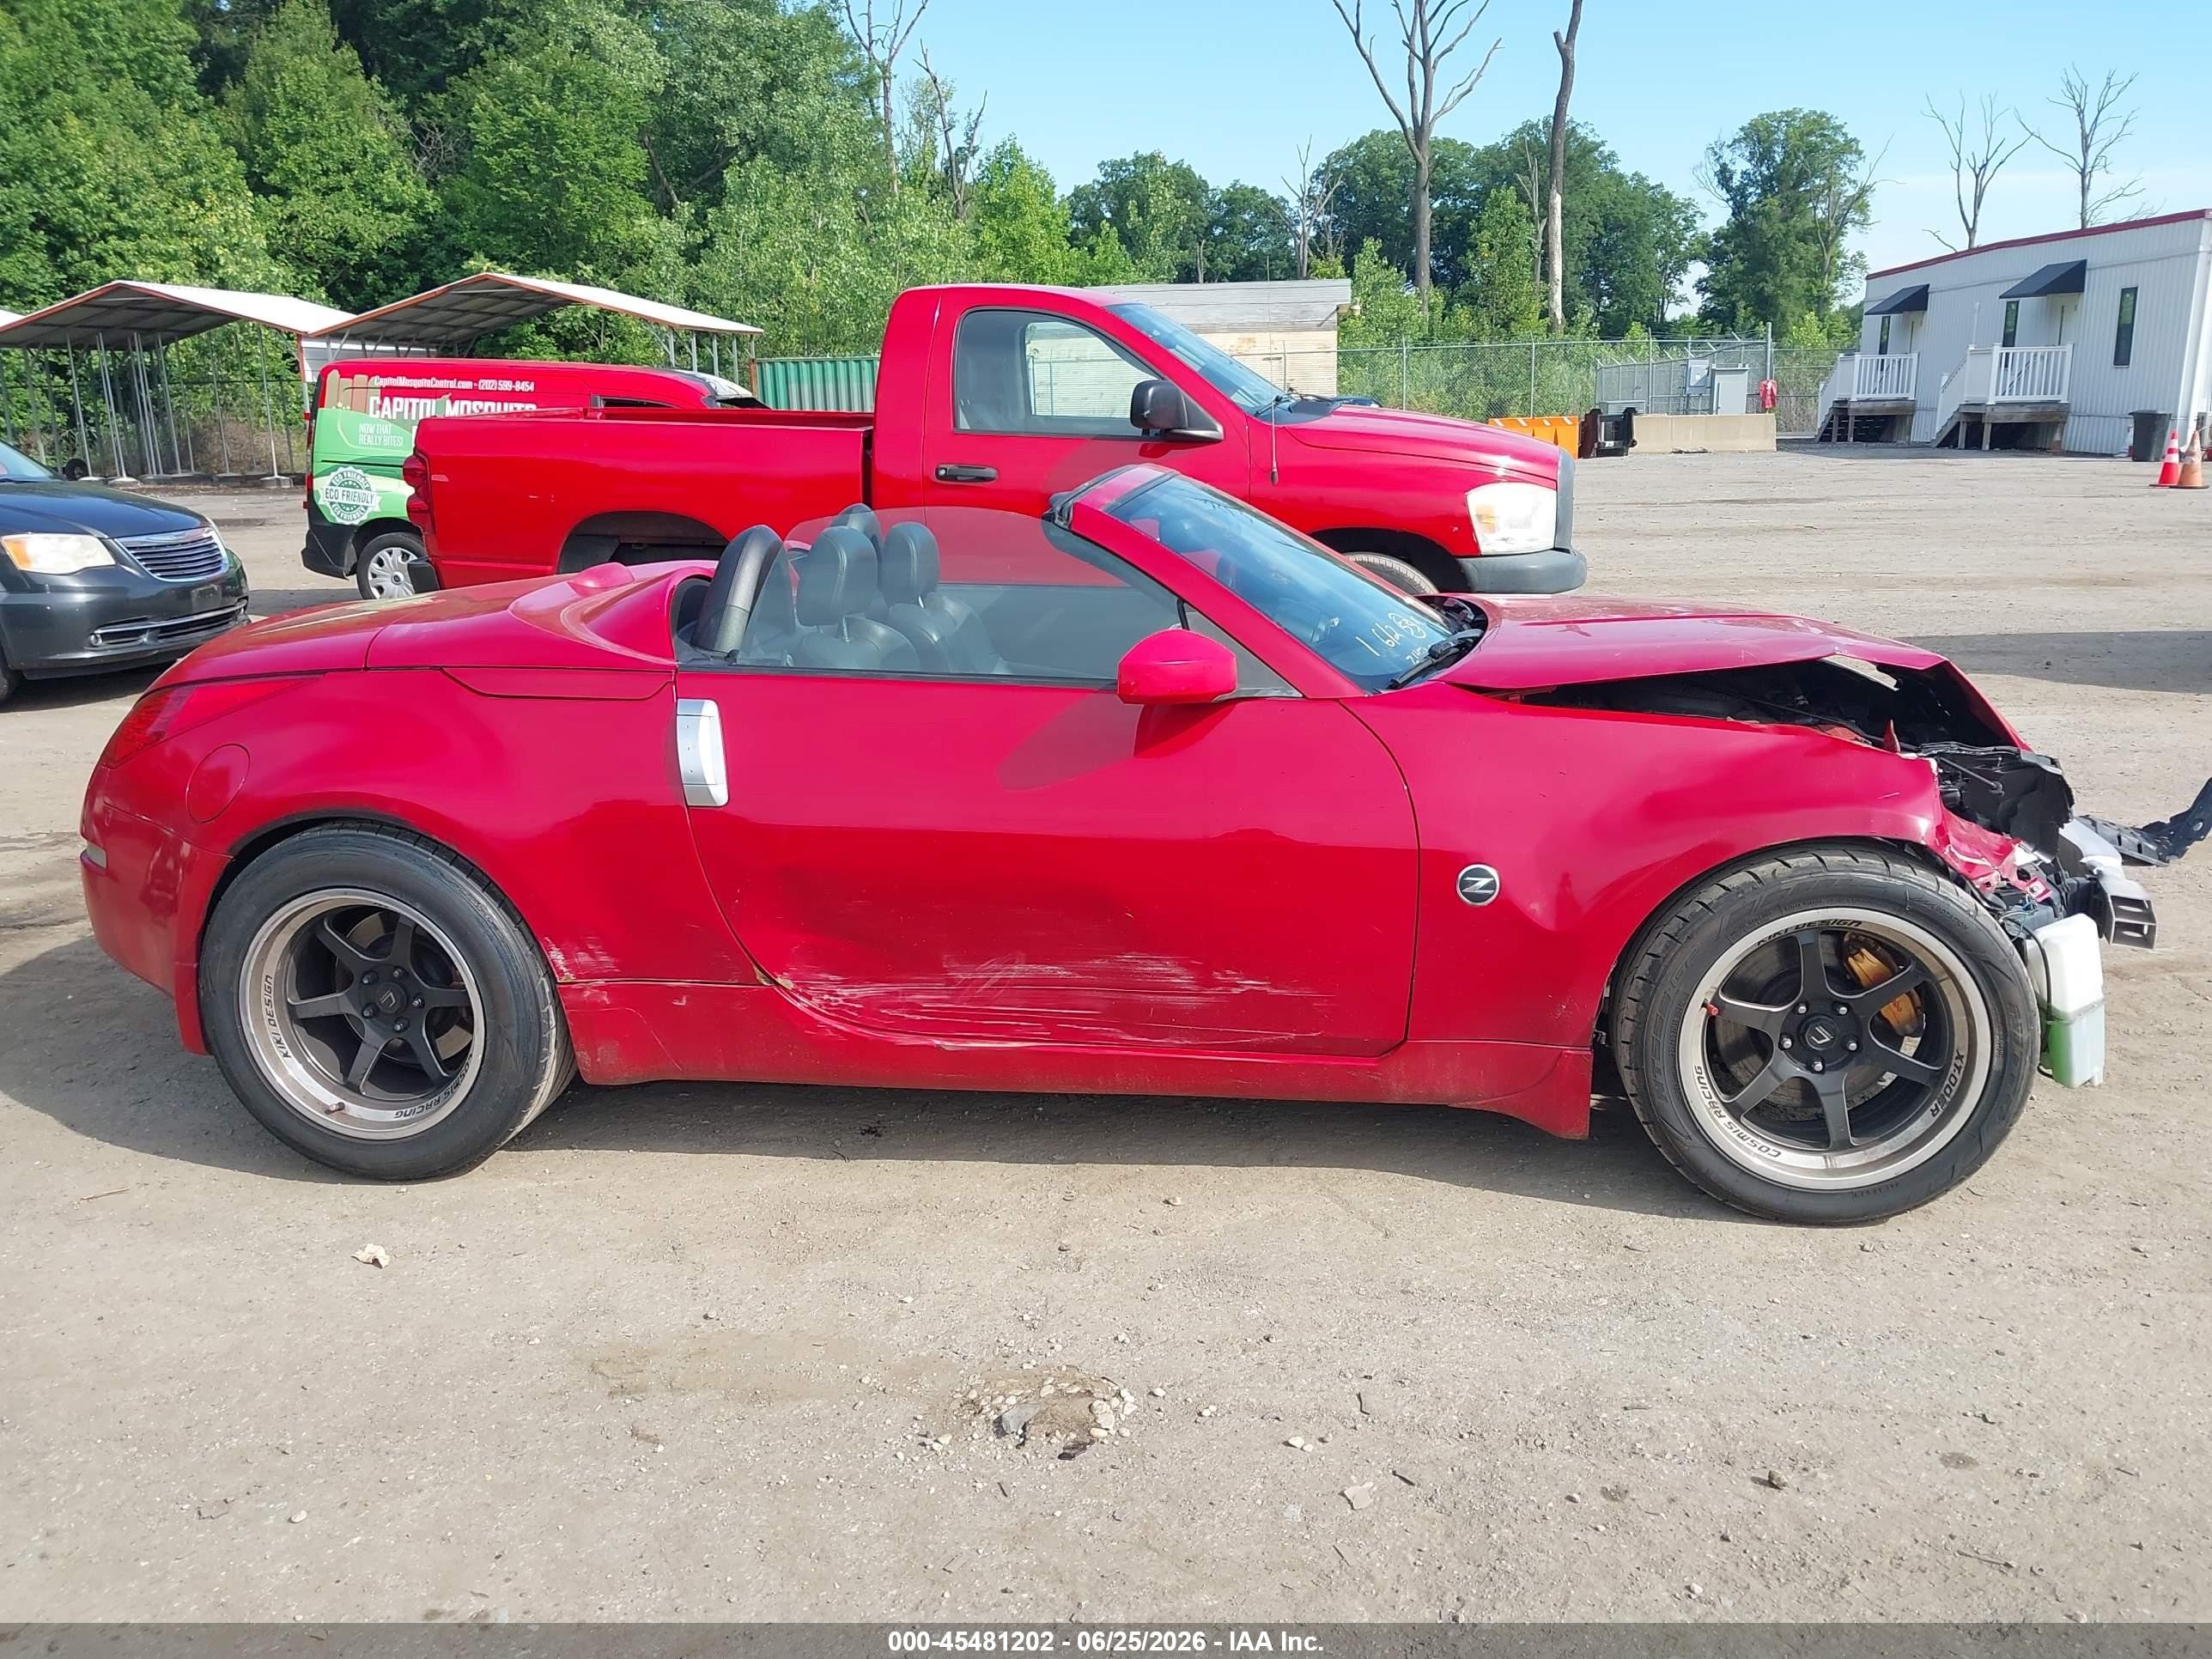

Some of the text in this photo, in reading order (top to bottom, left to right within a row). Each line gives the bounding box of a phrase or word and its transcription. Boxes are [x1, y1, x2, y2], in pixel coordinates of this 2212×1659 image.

[374, 375, 473, 390] CapitolMosquitoControl.com
[478, 379, 497, 391] (202)
[498, 380, 535, 392] 599-8454
[368, 395, 538, 421] CAPITOL MOSQ
[358, 422, 392, 435] NOW THAT
[358, 433, 383, 446] REALLY
[325, 487, 374, 505] ECO FRIENDLY
[264, 975, 292, 1059] KIKI DESIGN
[393, 1097, 441, 1119] RACING
[1694, 1065, 1783, 1158] COSMIS RACING
